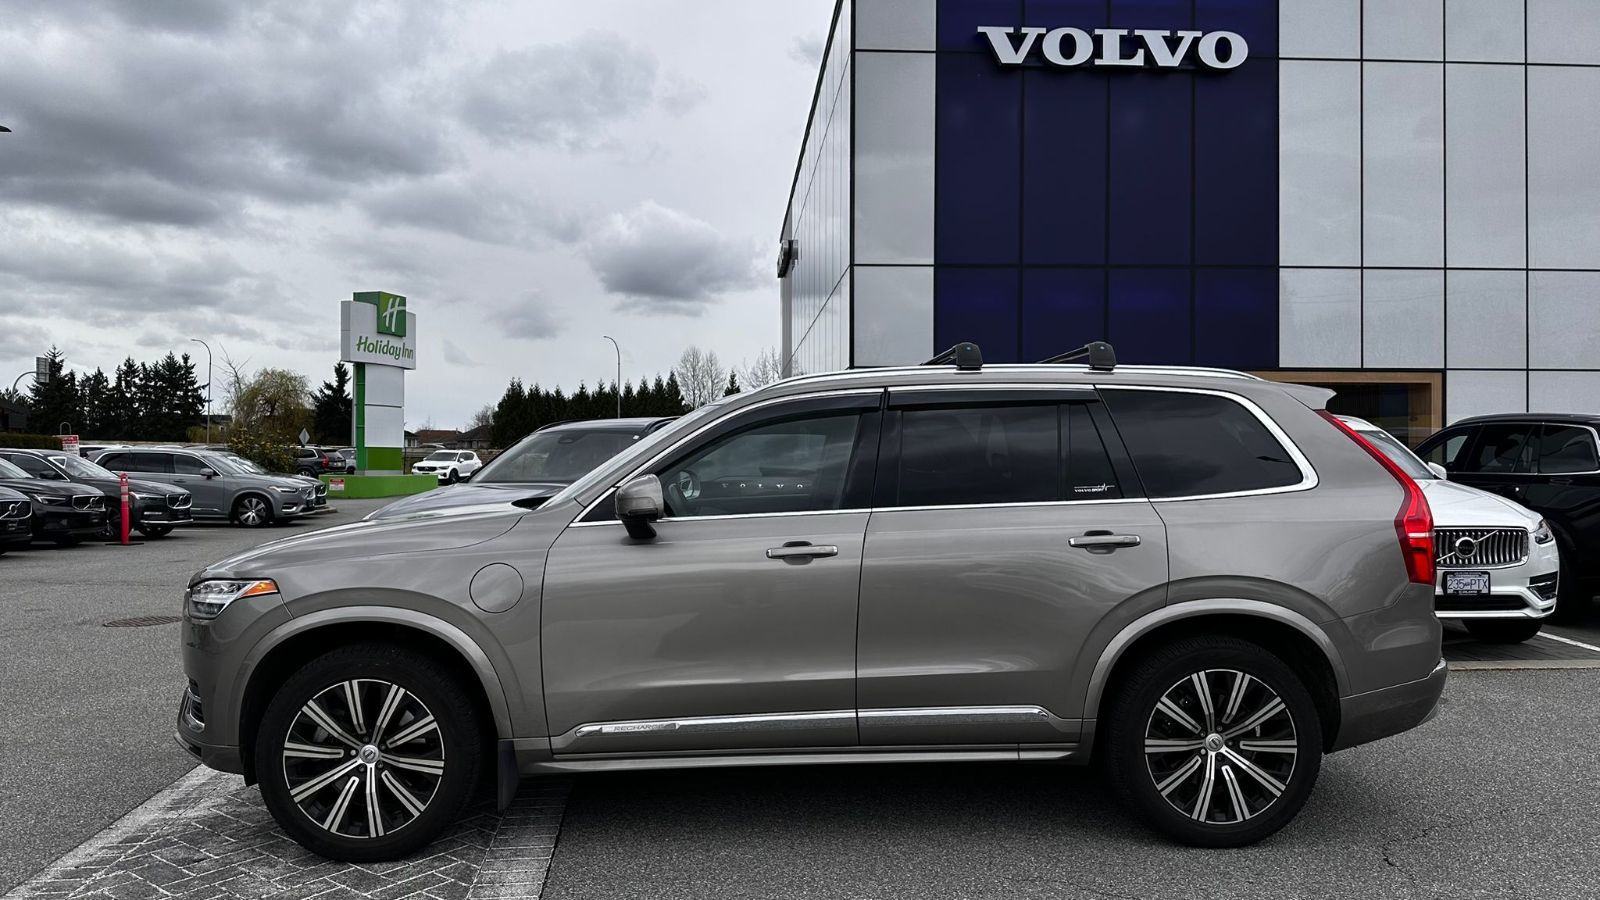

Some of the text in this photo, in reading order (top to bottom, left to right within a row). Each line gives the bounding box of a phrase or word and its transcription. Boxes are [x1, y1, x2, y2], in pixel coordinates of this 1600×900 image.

[977, 26, 1249, 69] VOLVO
[356, 335, 414, 360] Holiday Inn
[614, 723, 665, 732] RECHARGE
